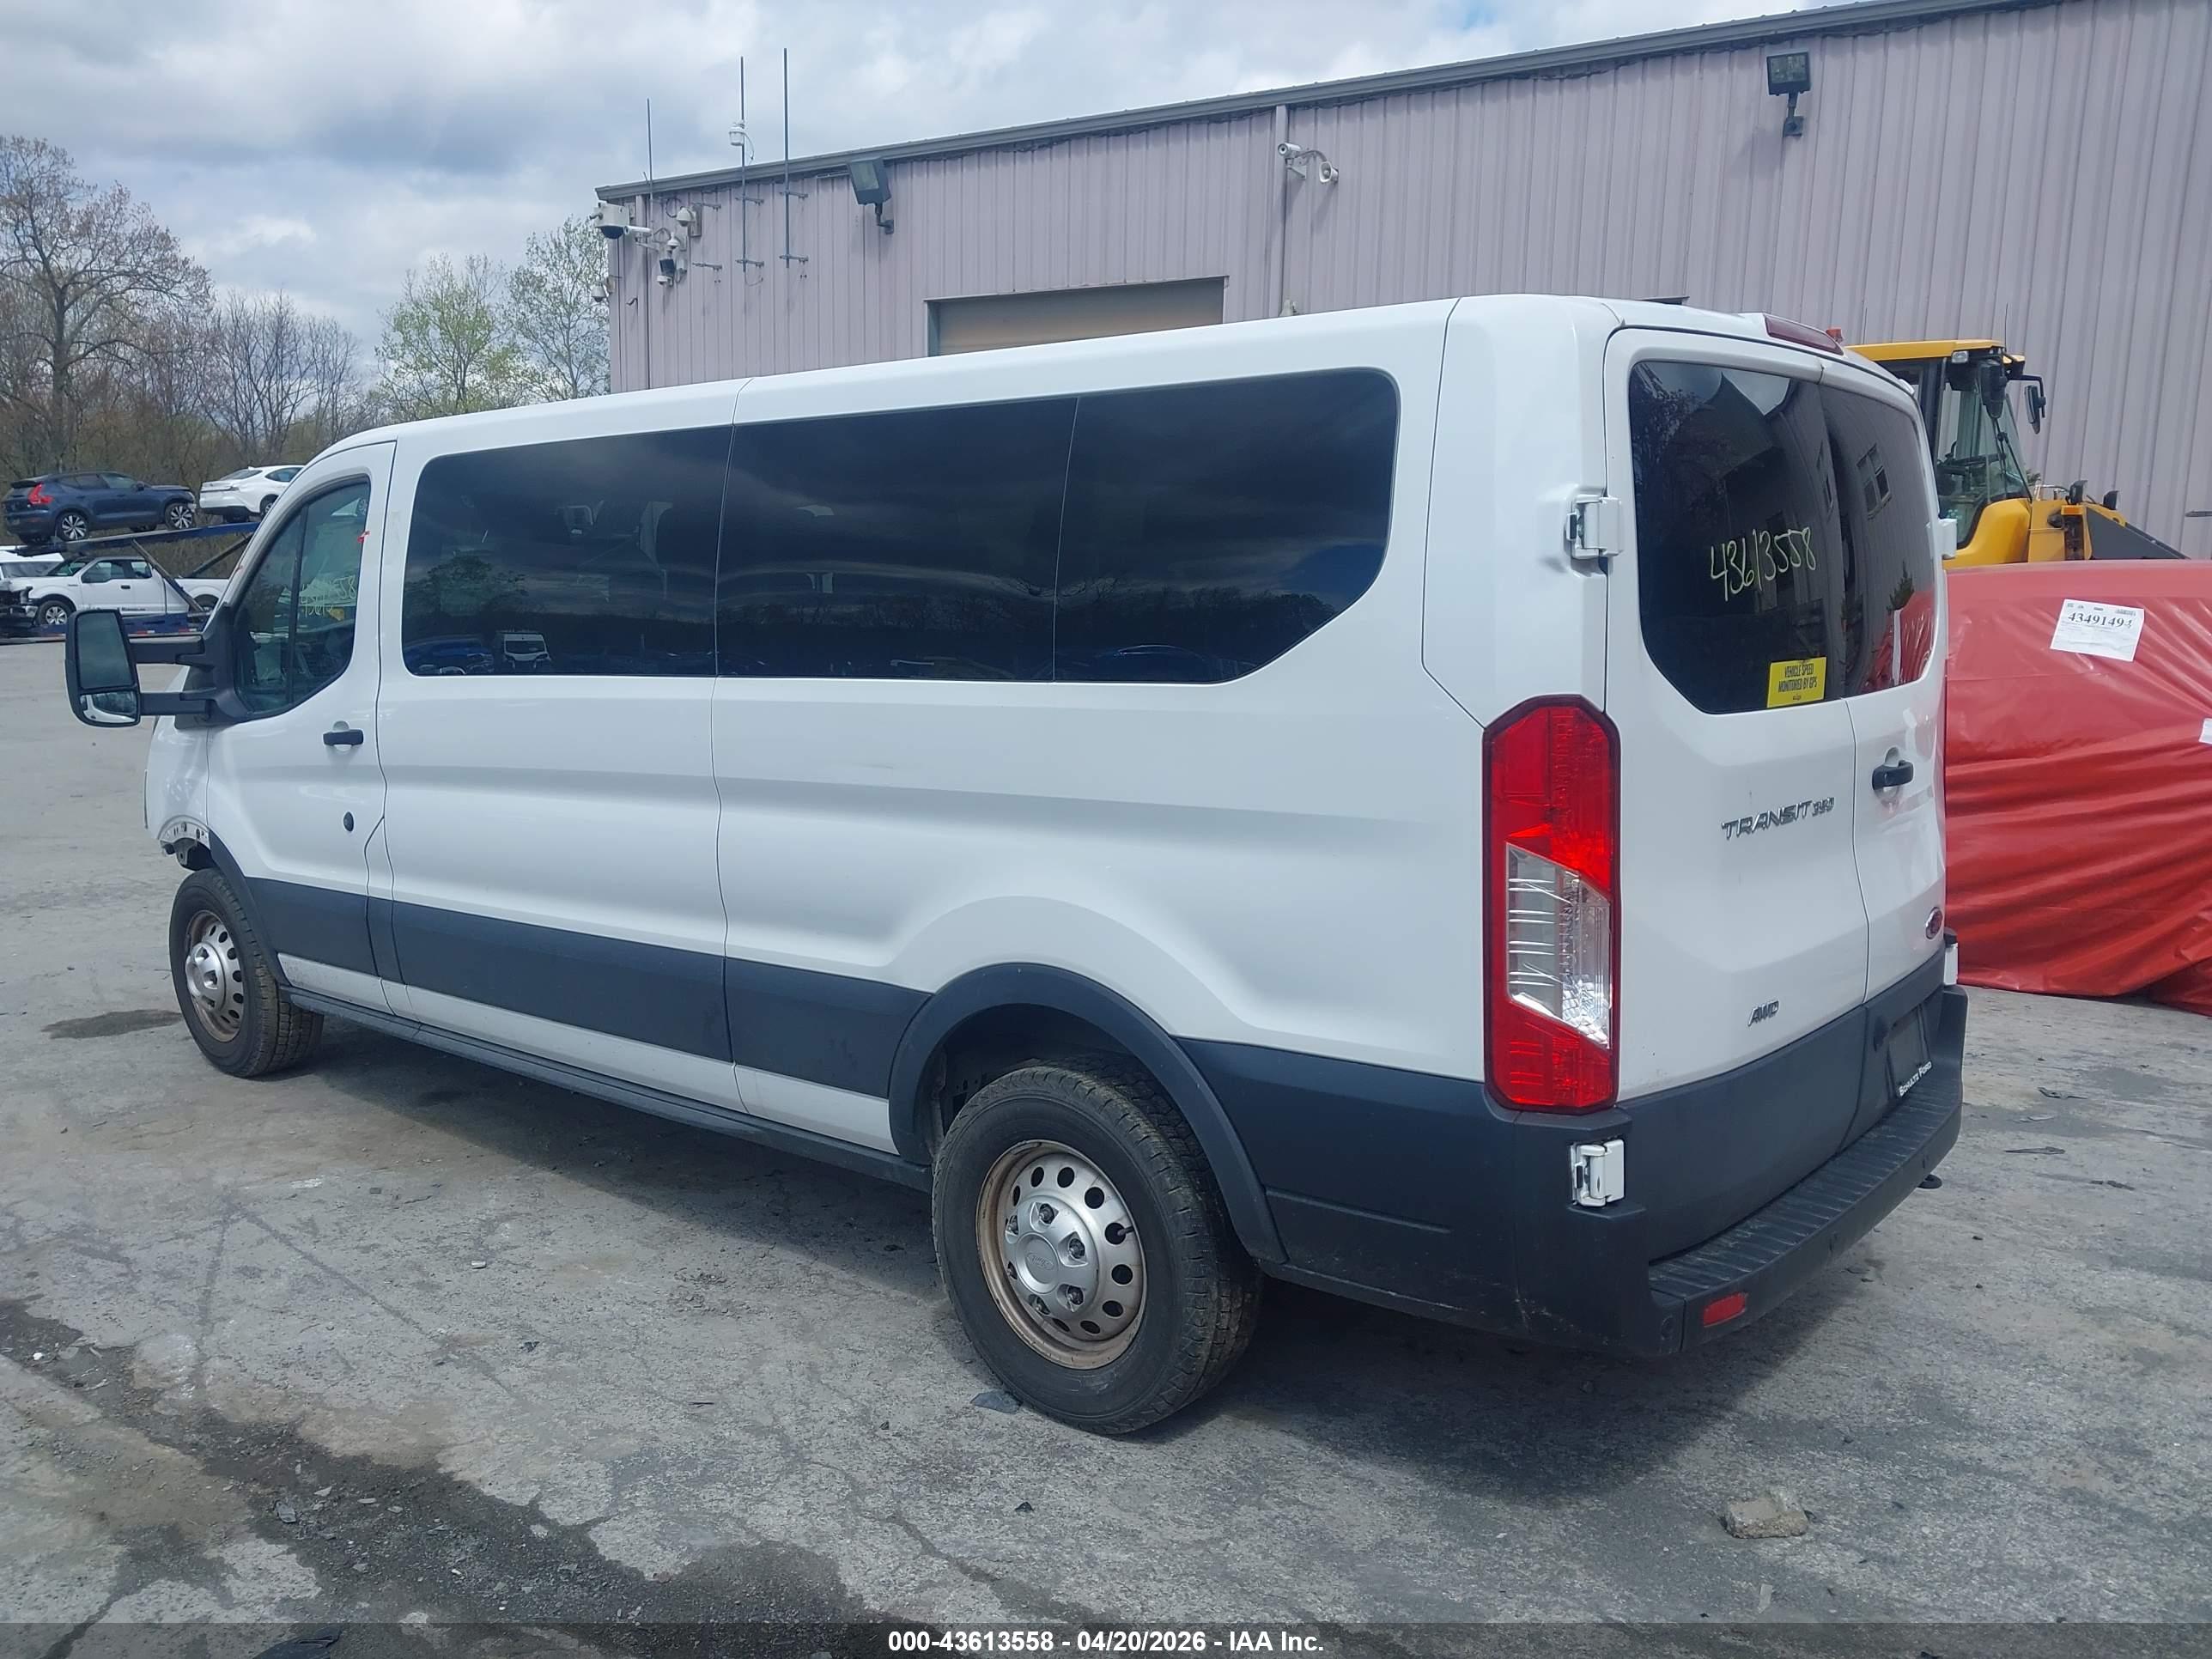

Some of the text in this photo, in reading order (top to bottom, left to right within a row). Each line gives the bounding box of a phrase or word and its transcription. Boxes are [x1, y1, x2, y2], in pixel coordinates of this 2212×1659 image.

[1711, 526, 1816, 602] 43613558
[1785, 663, 1814, 678] VEHICLE SPEED
[1803, 677, 1809, 690] BY
[1809, 676, 1818, 688] GPS
[1721, 799, 1813, 841] TRANSIT
[1747, 1000, 1779, 1027] AWD
